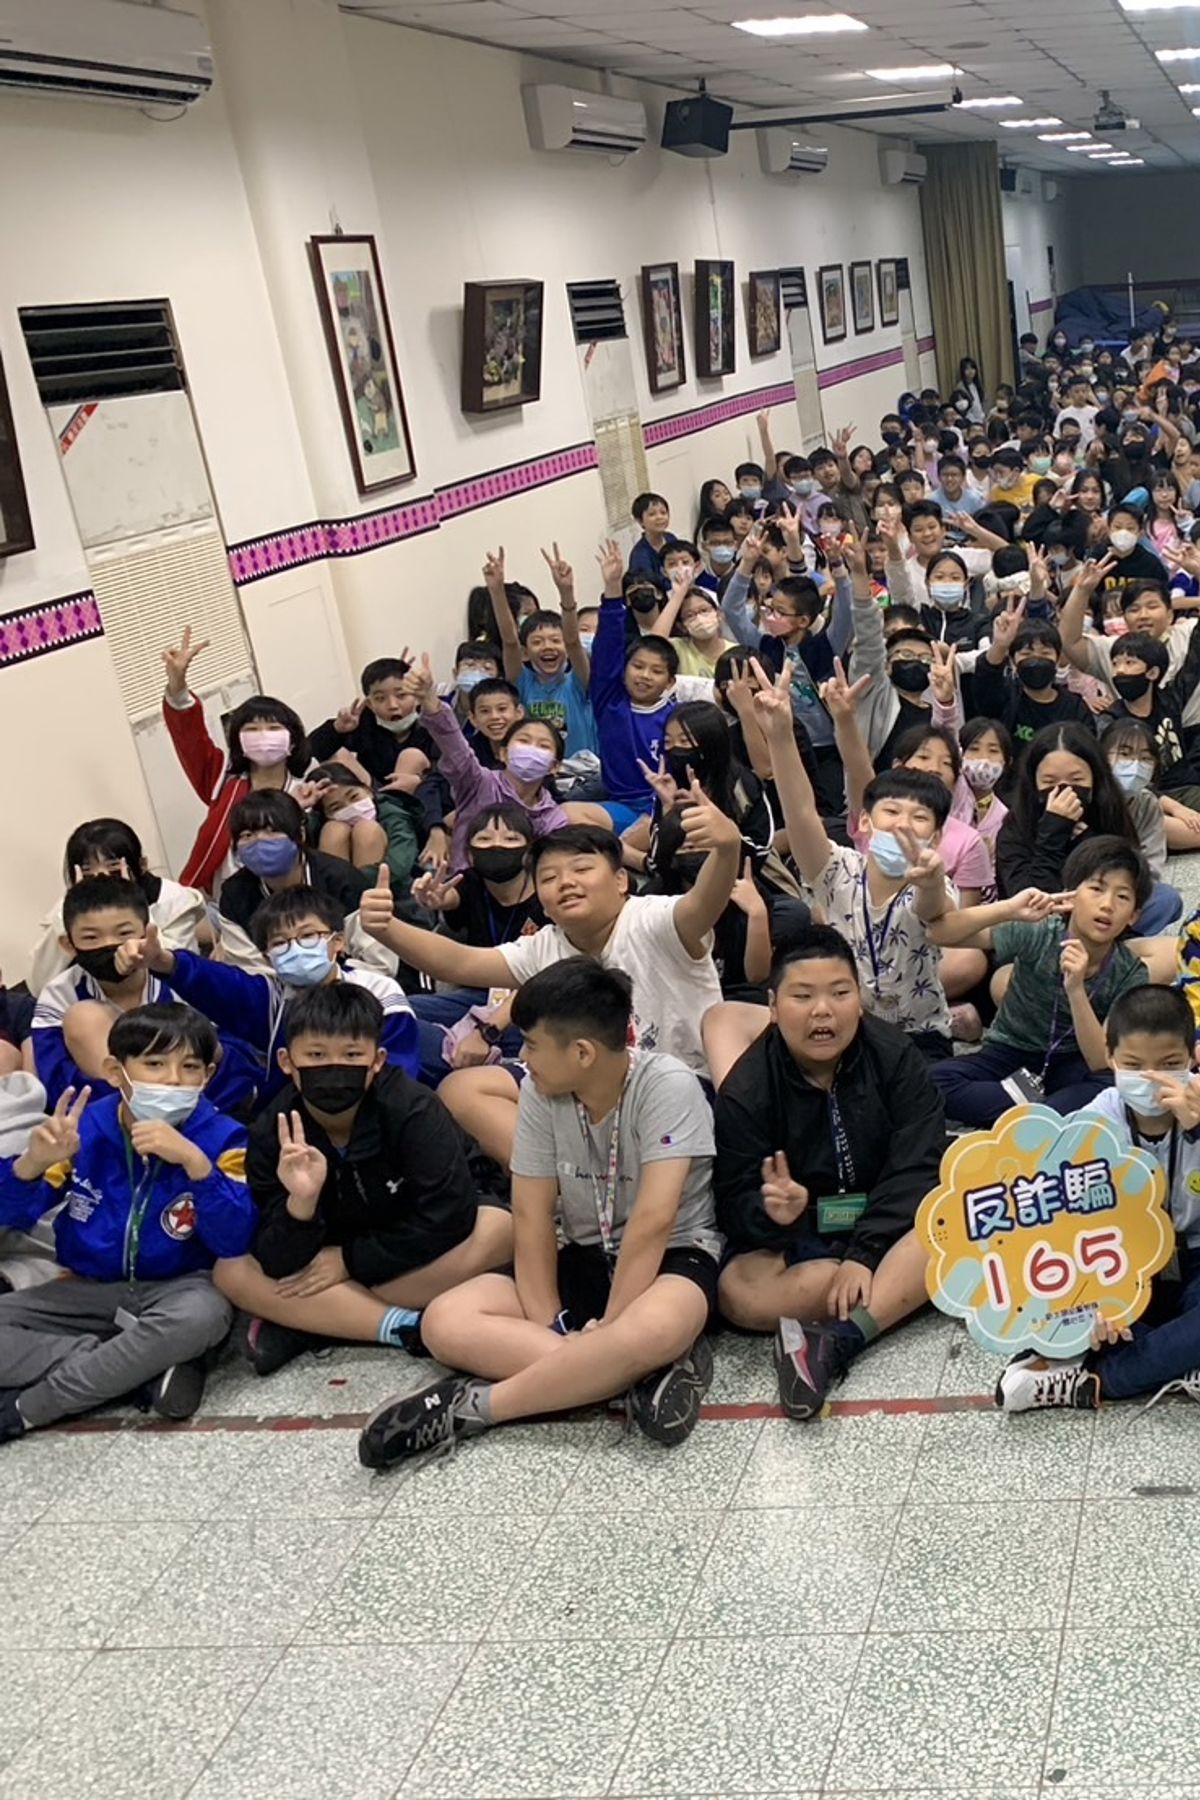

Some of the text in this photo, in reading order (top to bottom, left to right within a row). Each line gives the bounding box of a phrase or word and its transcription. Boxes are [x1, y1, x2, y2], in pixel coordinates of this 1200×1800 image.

[965, 1160, 1114, 1239] 反詐騙
[986, 1230, 1124, 1307] 165
